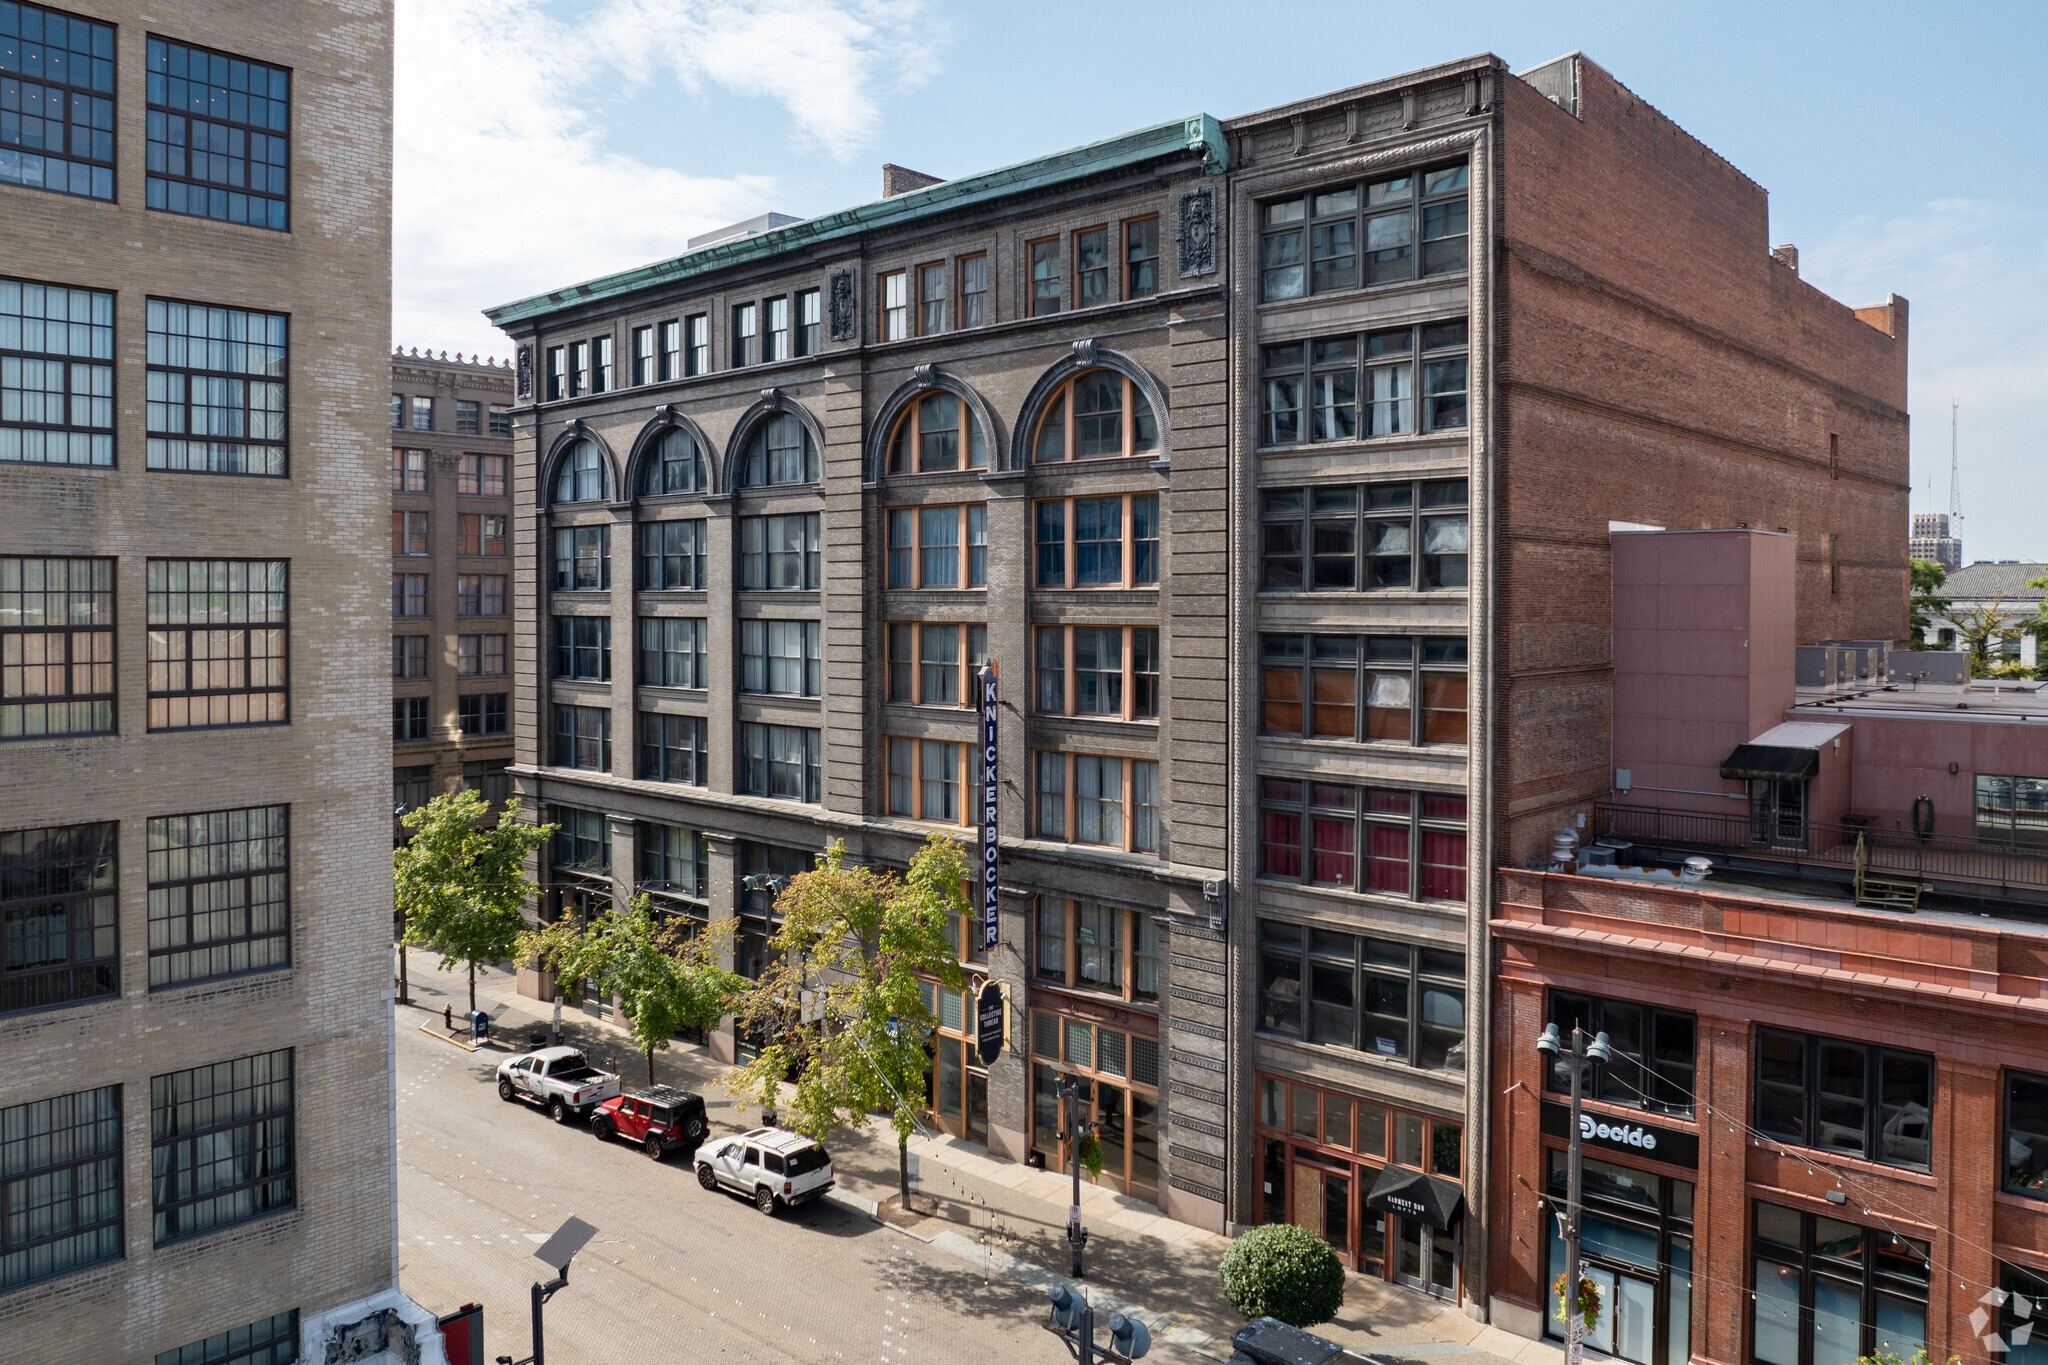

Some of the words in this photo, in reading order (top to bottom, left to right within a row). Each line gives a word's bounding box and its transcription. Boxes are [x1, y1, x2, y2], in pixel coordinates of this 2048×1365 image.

[984, 682, 997, 943] KNICKERBOCKER
[980, 1008, 1002, 1021] COLLECTIVE
[983, 1017, 999, 1028] THREAD
[1579, 1114, 1657, 1150] Decide
[1392, 1204, 1417, 1215] LOFTS
[1572, 1328, 1583, 1342] 25
